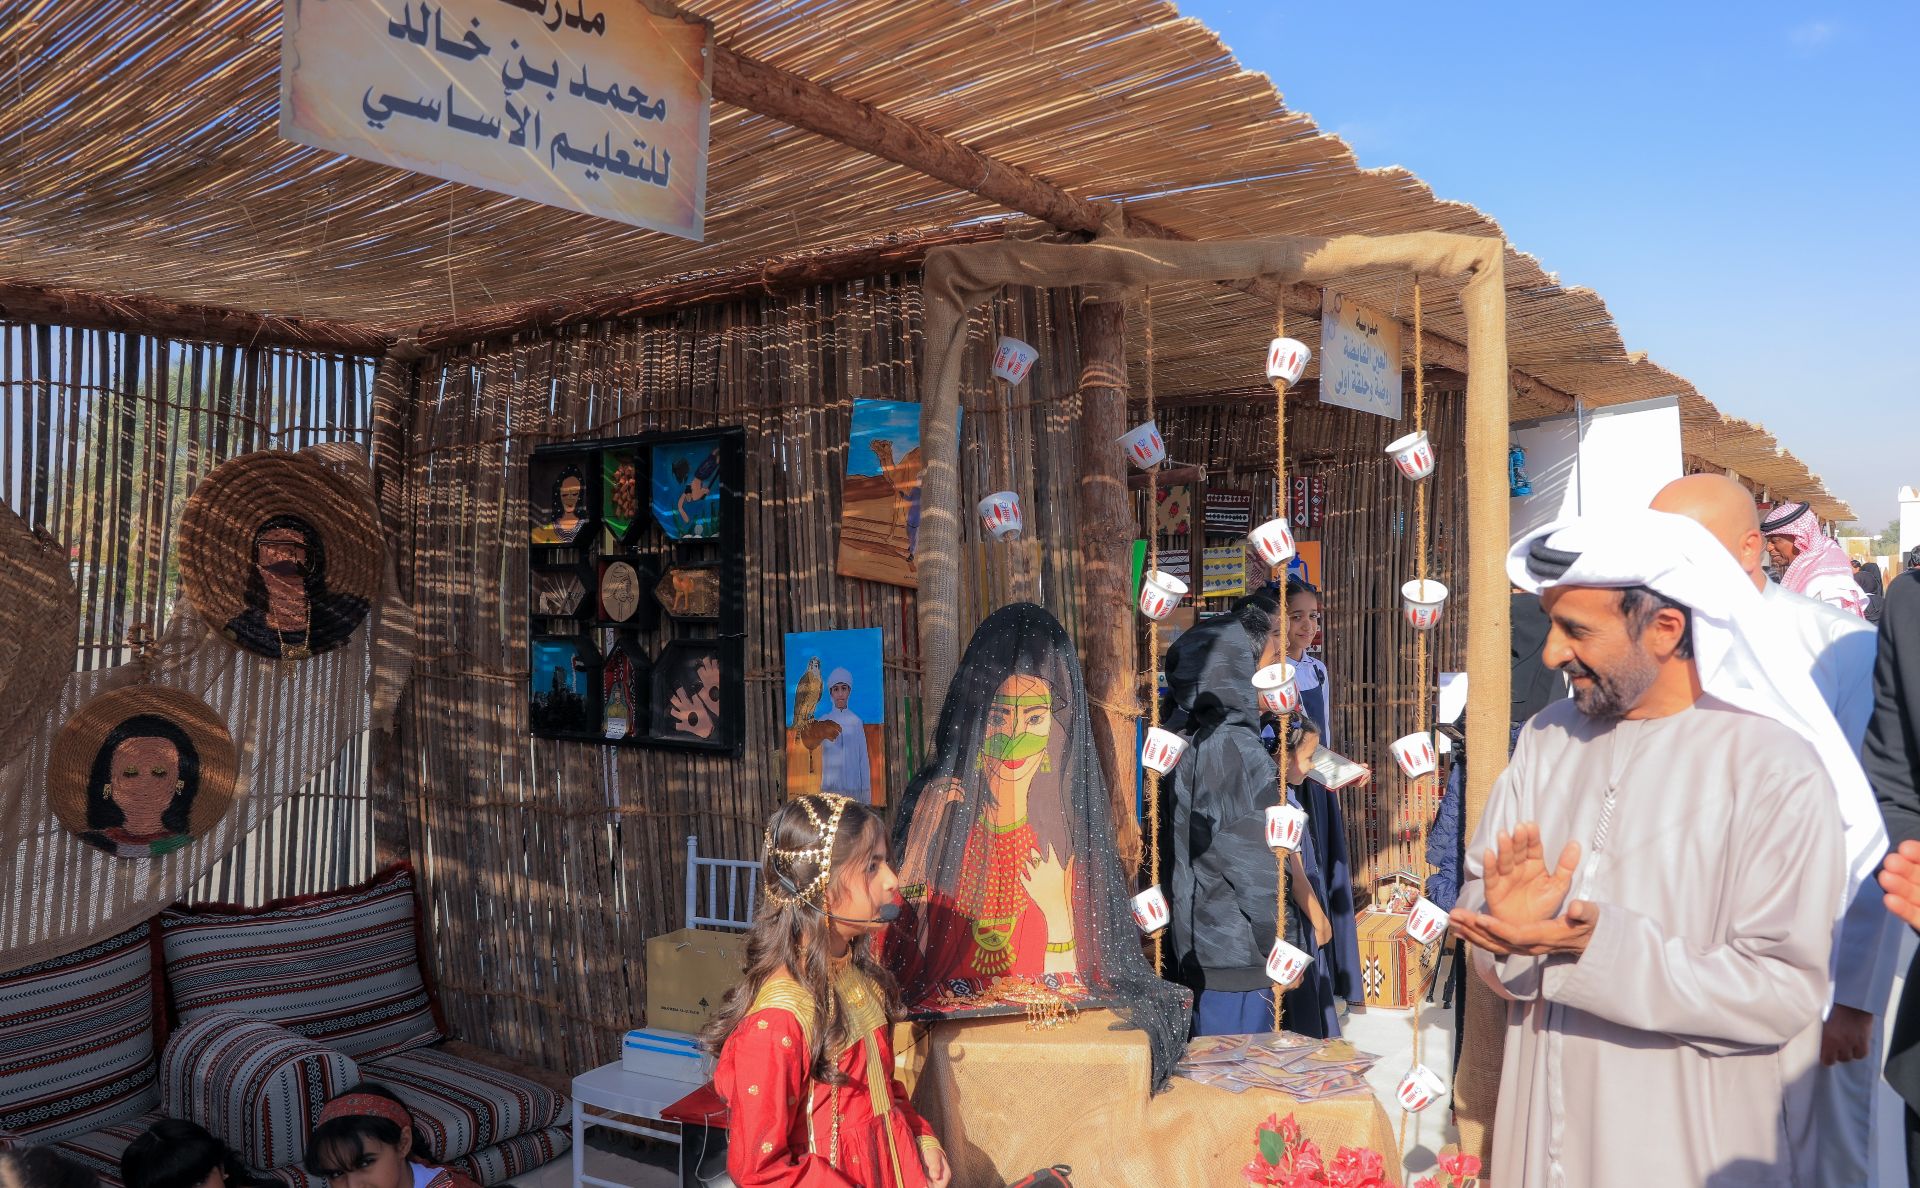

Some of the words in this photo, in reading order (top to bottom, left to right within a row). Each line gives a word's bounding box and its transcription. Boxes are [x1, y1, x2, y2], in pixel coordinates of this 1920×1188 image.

[389, 1, 490, 61] خالد
[502, 39, 559, 104] بن
[570, 65, 666, 122] محمد
[362, 83, 541, 150] الأساسي
[551, 132, 671, 187] للتعليم
[1355, 308, 1378, 338] مدرسة
